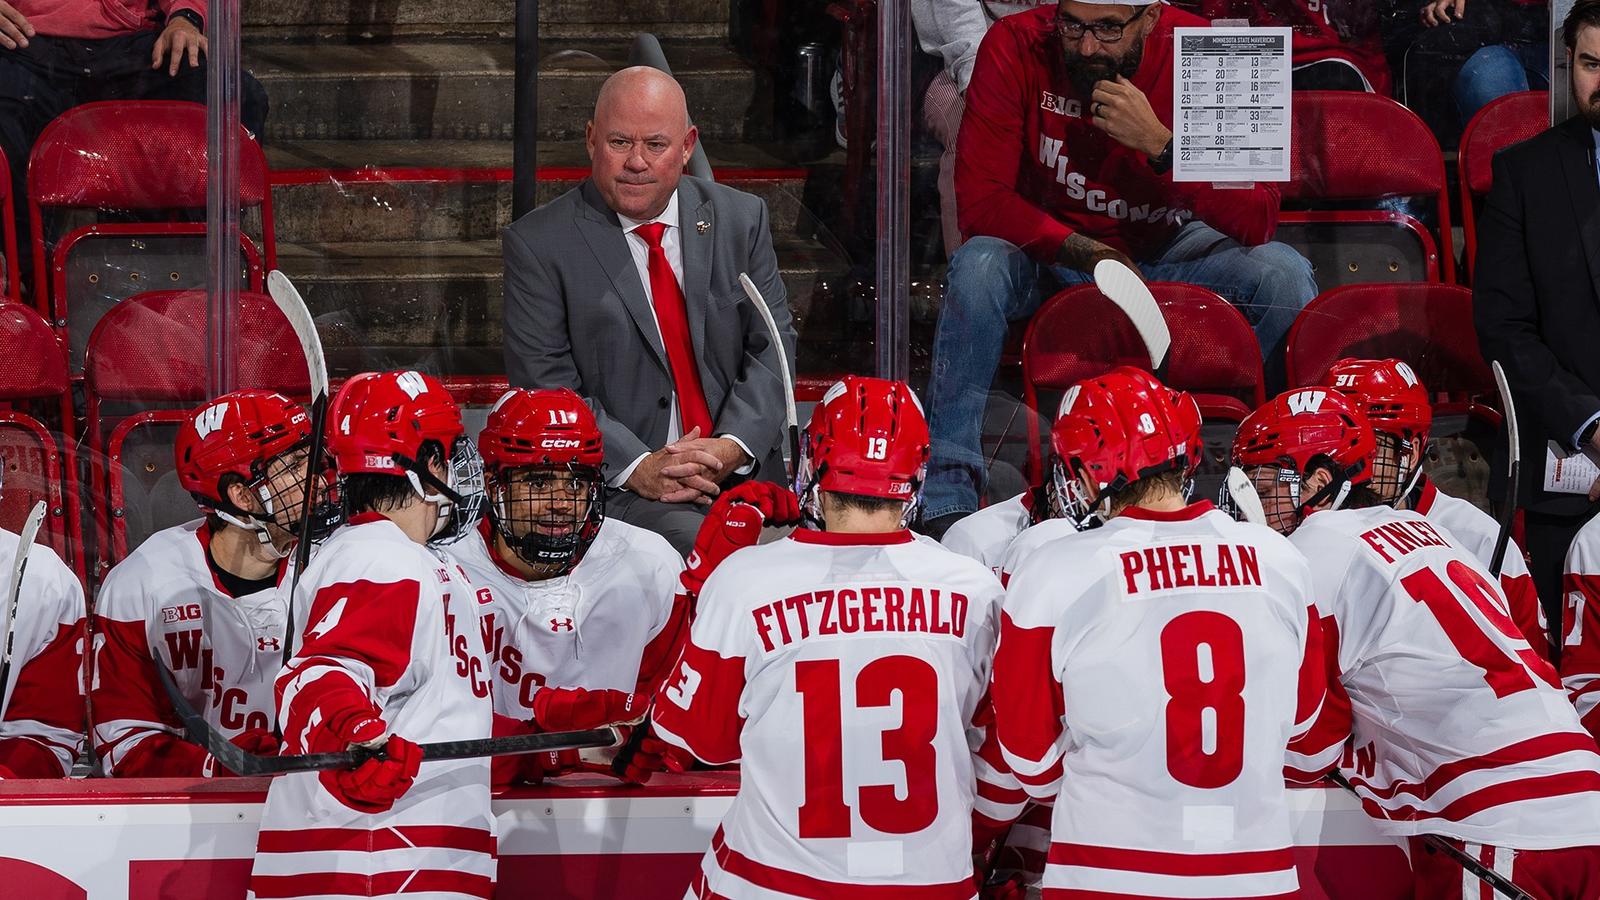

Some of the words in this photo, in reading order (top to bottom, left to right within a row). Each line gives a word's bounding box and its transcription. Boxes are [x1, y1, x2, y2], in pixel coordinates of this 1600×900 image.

[1181, 57, 1191, 67] 23
[1218, 57, 1224, 67] 9
[1251, 57, 1259, 67] 13
[1181, 69, 1191, 79] 24
[1215, 69, 1225, 79] 20
[1251, 69, 1259, 79] 12
[1183, 82, 1189, 91] 11
[1215, 82, 1225, 91] 27
[1251, 82, 1259, 91] 16
[1181, 94, 1191, 104] 25
[1216, 94, 1224, 104] 18
[1250, 94, 1260, 104] 44
[1183, 110, 1189, 120] 4
[1215, 110, 1224, 120] 10
[1249, 110, 1260, 120] 33
[1217, 122, 1223, 132] 8
[1250, 123, 1259, 133] 31
[1181, 135, 1191, 145] 39
[1214, 135, 1225, 145] 26
[1180, 151, 1191, 161] 22
[1217, 151, 1223, 161] 7
[1335, 374, 1357, 387] 91
[1288, 391, 1327, 417] W
[194, 402, 229, 441] W
[340, 414, 351, 436] 4
[1140, 413, 1156, 434] 8
[541, 439, 581, 449] CCM
[866, 437, 888, 460] 13
[1119, 544, 1262, 594] PHELAN
[752, 587, 969, 653] FITZGERALD
[1160, 610, 1246, 790] 8
[795, 655, 939, 838] 13
